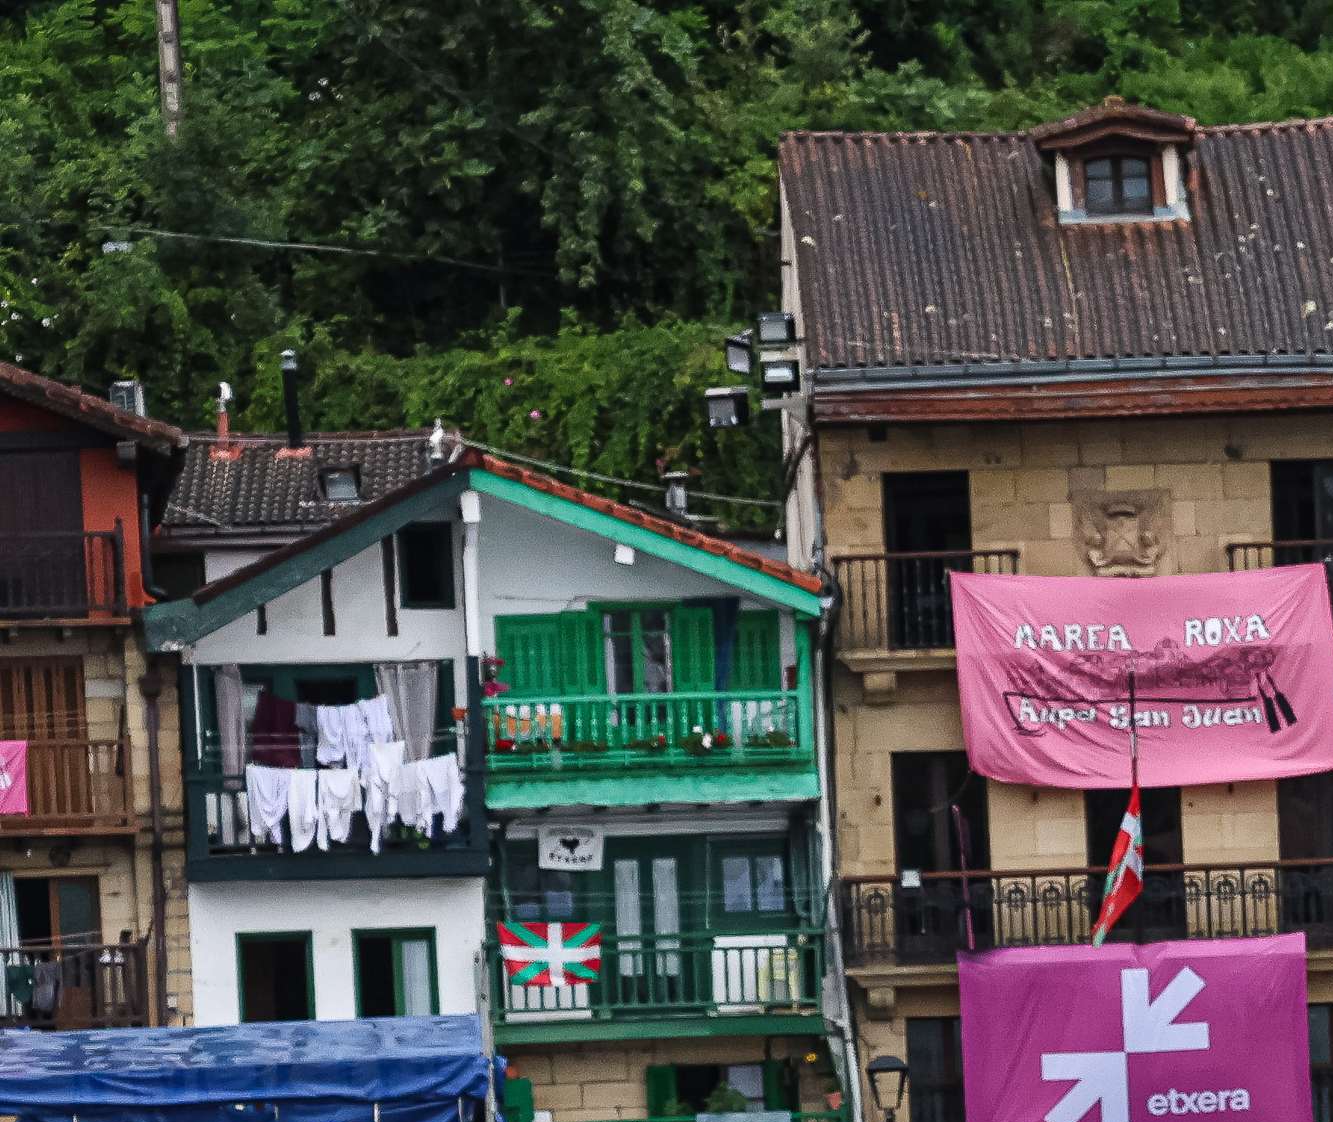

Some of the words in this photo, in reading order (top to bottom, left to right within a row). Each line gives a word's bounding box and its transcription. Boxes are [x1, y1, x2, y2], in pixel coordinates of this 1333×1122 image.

[1184, 614, 1271, 647] ROXA
[1108, 704, 1171, 729] San
[1182, 703, 1263, 729] Juan
[1146, 1087, 1251, 1117] etxera
